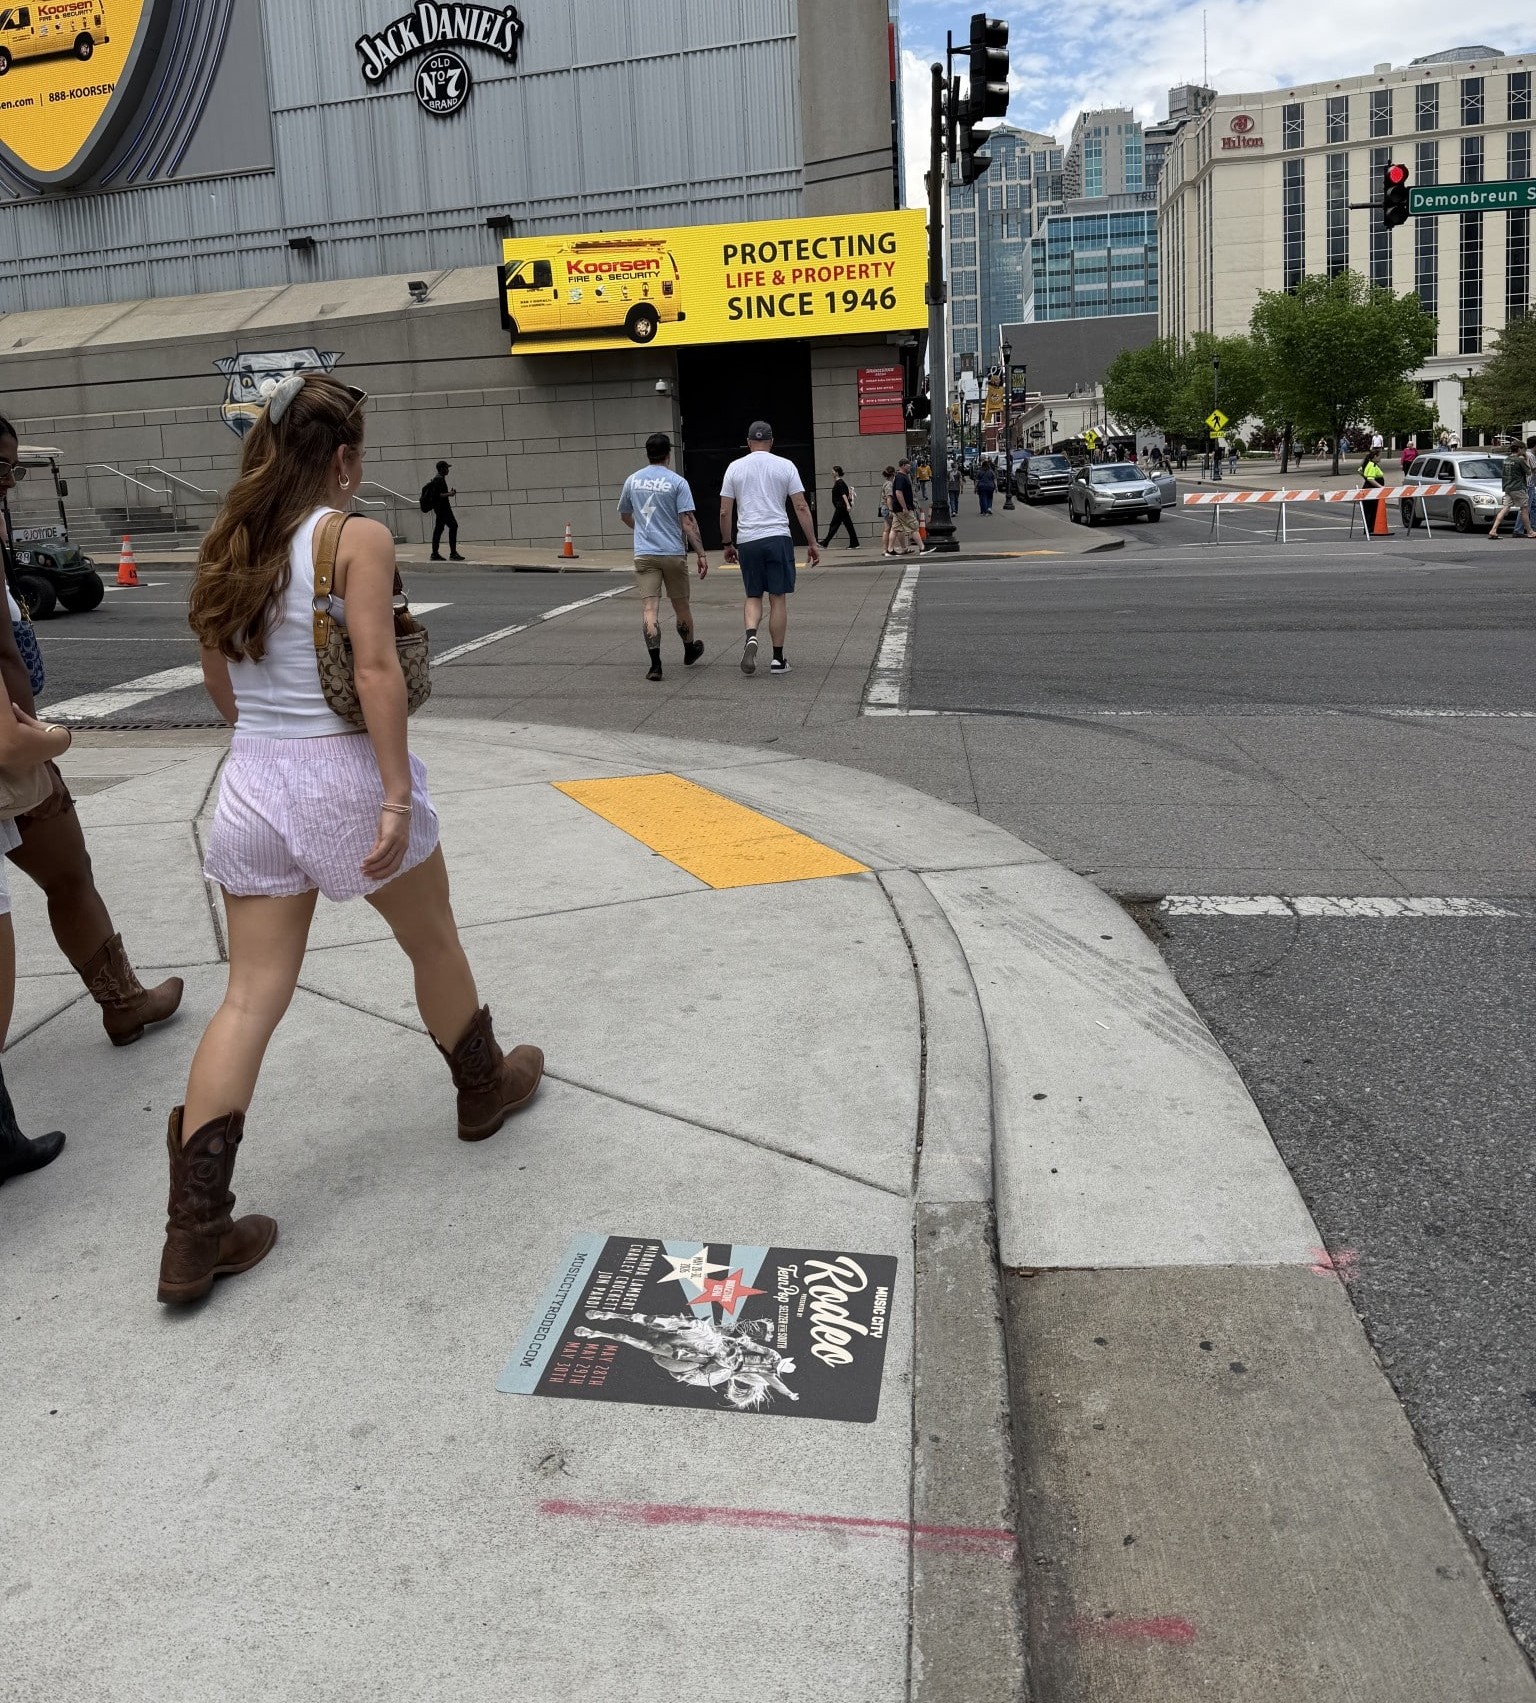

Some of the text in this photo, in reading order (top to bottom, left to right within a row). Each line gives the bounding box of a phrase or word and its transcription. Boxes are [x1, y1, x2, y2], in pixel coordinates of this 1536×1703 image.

[38, 0, 93, 16] Koorsen
[63, 9, 93, 19] SECURITY
[359, 3, 519, 79] JACK DANIEL'S
[431, 58, 450, 69] OLD
[0, 83, 116, 110] en.com 888-KOORSEN
[429, 98, 458, 110] BRAND
[1221, 135, 1264, 150] Hilton
[1414, 190, 1518, 208] Demonbreun
[723, 232, 897, 266] PROTECTING
[567, 258, 661, 275] Koorsen
[568, 270, 661, 283] FIRE & SECURITY
[726, 261, 896, 289] LIFE & PROPERTY
[728, 286, 897, 321] SINCE 1946
[631, 475, 672, 493] hustle
[692, 1256, 704, 1266] MAY
[584, 1271, 613, 1309] JON PARDI
[602, 1244, 644, 1311] CHARLEY CROCKETT
[619, 1245, 660, 1311] MIRANDA LAMBERT
[520, 1252, 588, 1367] MUSICCITYRODEO.COM
[778, 1304, 788, 1324] SELTZER
[803, 1256, 869, 1368] Rodeo
[869, 1286, 889, 1339] MUSIC CITY
[776, 1333, 787, 1349] SOUTH
[548, 1341, 581, 1384] MAY 30TH
[568, 1343, 599, 1385] MAY 29TH
[588, 1344, 619, 1386] MAY 28TH
